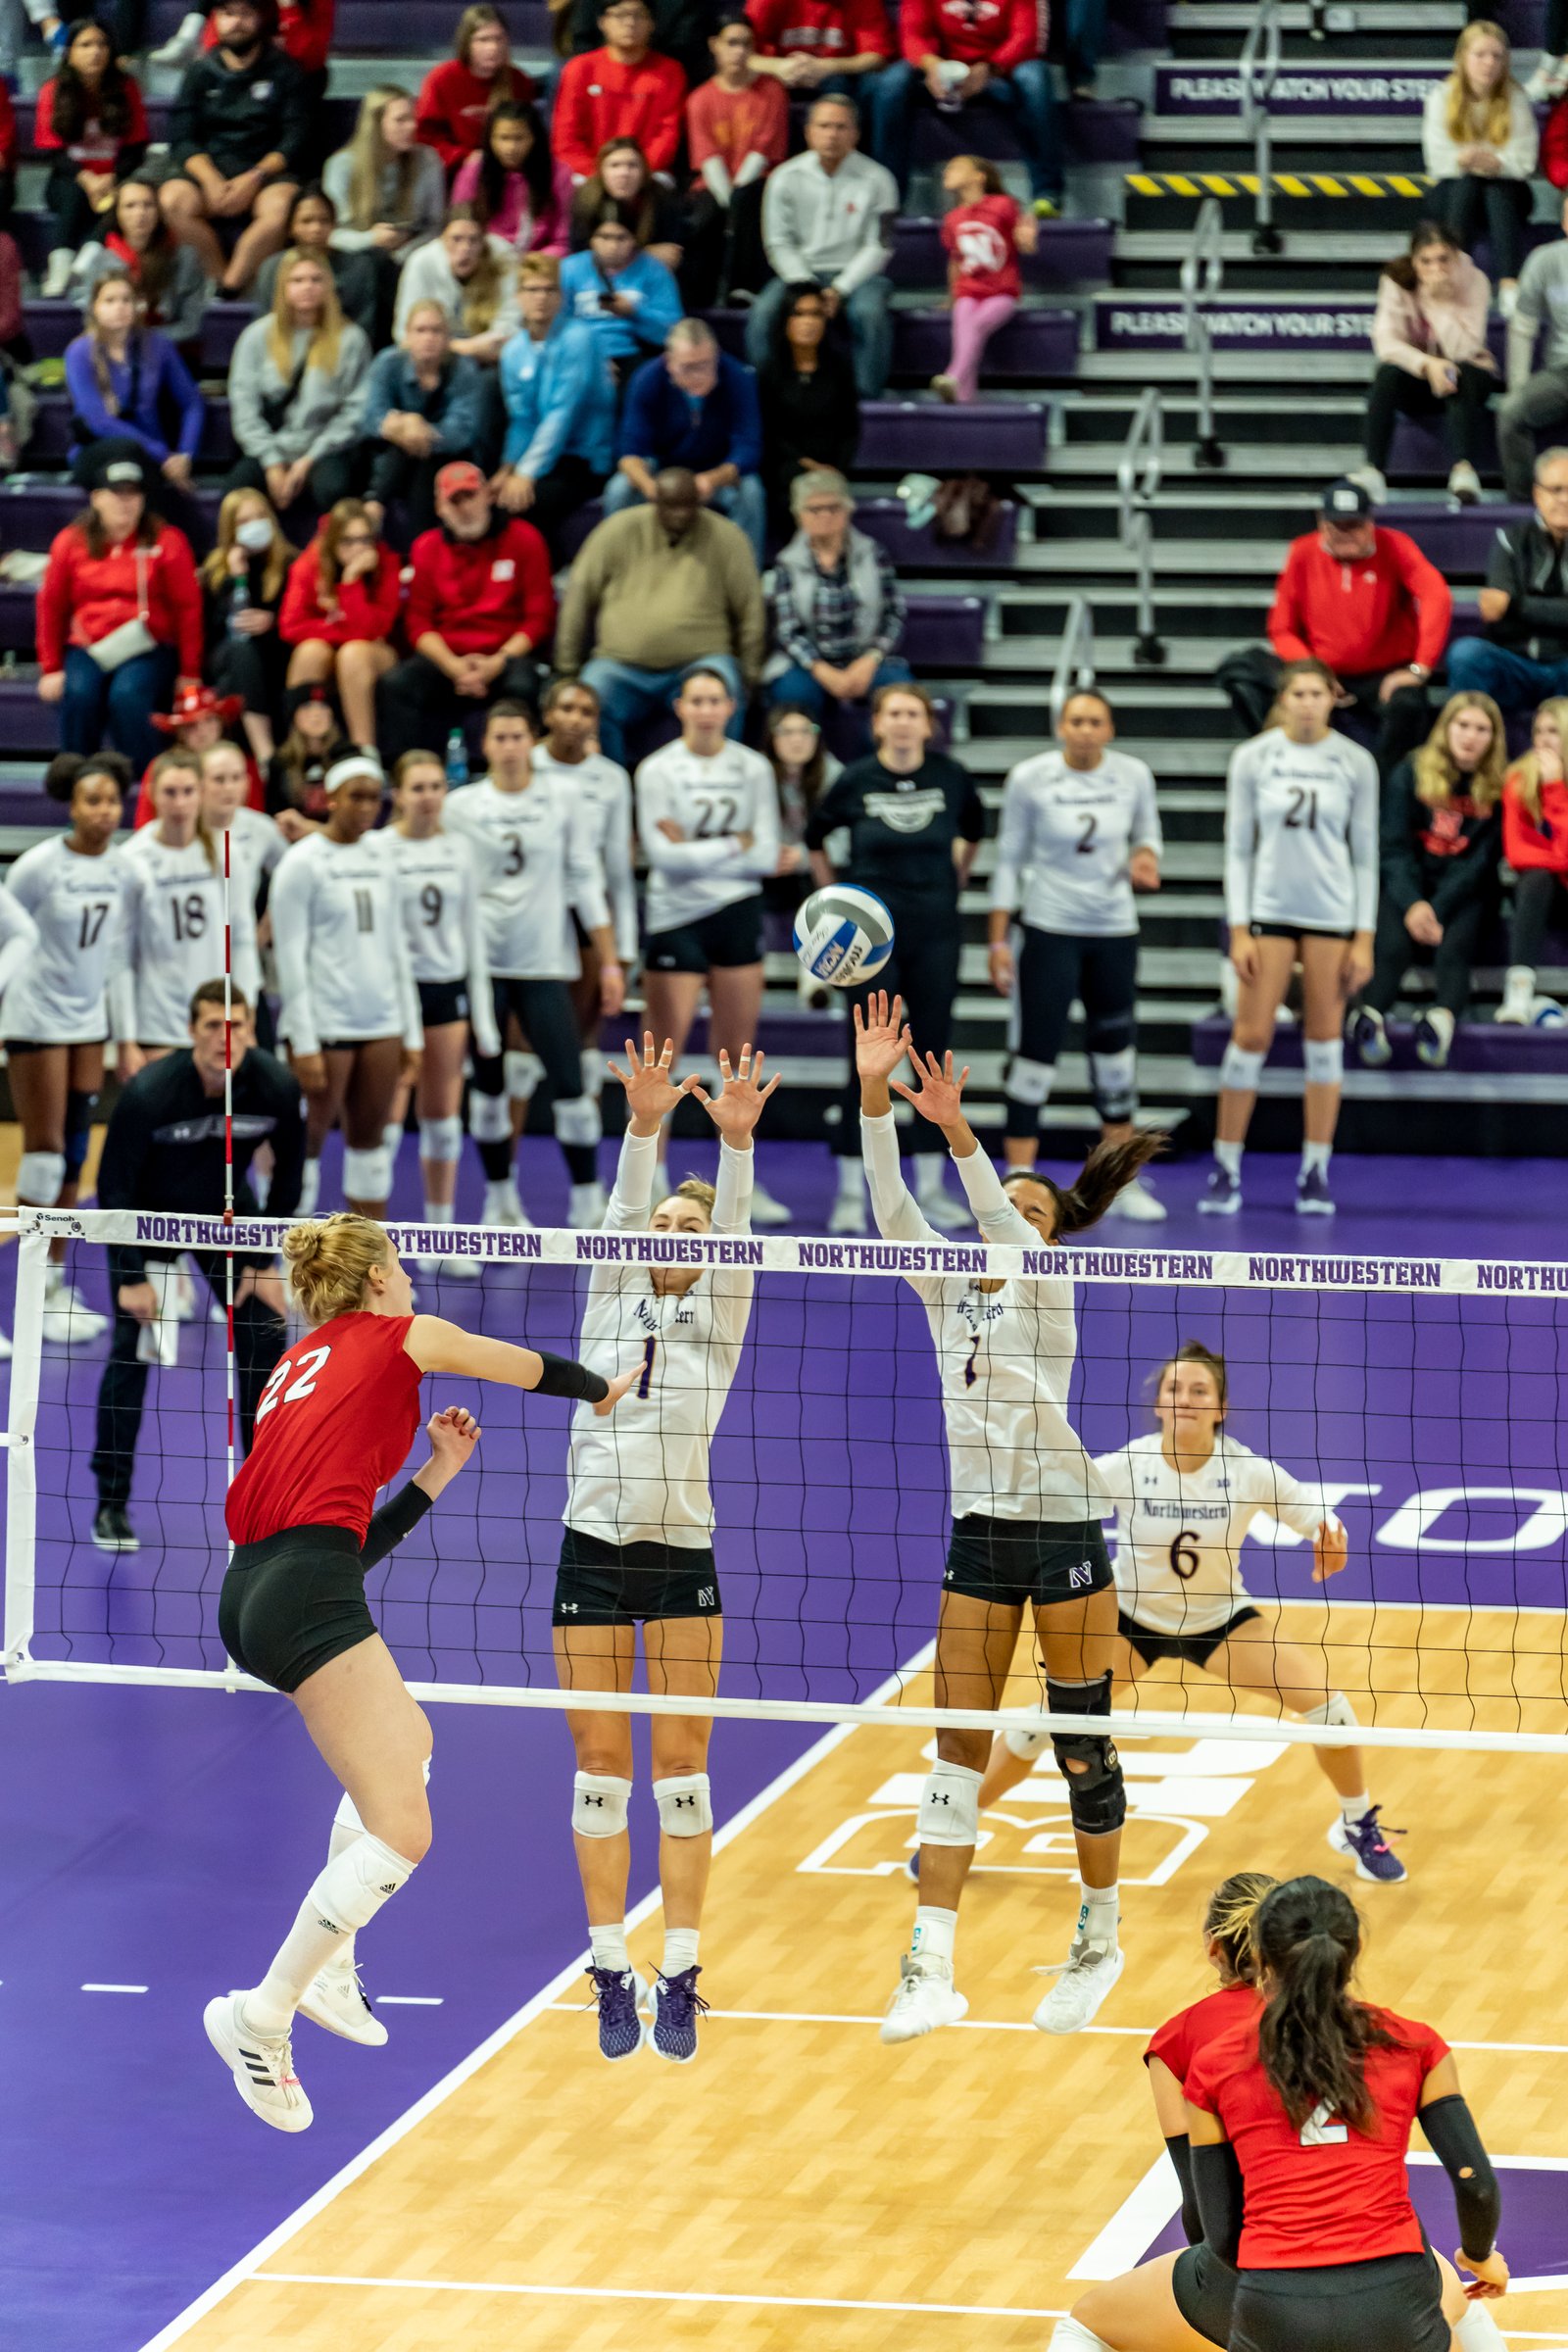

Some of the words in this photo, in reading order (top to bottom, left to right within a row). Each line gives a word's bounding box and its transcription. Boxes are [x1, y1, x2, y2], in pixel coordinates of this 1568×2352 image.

[1170, 77, 1250, 100] PLEAS
[1329, 78, 1390, 101] YOUR
[1110, 312, 1188, 335] PLEAS
[1273, 313, 1334, 337] YOUR
[1335, 313, 1374, 337] STE
[693, 797, 738, 840] 22
[1284, 785, 1317, 831] 21
[502, 832, 525, 876] 3
[1076, 811, 1099, 855] 2
[78, 902, 109, 949] 17
[171, 893, 206, 941] 18
[353, 887, 374, 933] 11
[419, 882, 443, 928] 9
[136, 1215, 293, 1248] NORTHWESTE
[386, 1228, 542, 1257] RTHWESTERN
[575, 1236, 763, 1264] NORTHWESTERN
[798, 1243, 988, 1273] NORTHWESTERN
[1022, 1250, 1213, 1280] NORTHWESTERN
[1249, 1256, 1442, 1288] NORTHWESTERN
[256, 1345, 332, 1426] 22
[637, 1333, 657, 1399] 1
[1143, 1497, 1229, 1520] Northwestern
[1069, 1560, 1093, 1589] N
[1170, 1531, 1200, 1580] 6
[698, 1586, 715, 1607] N
